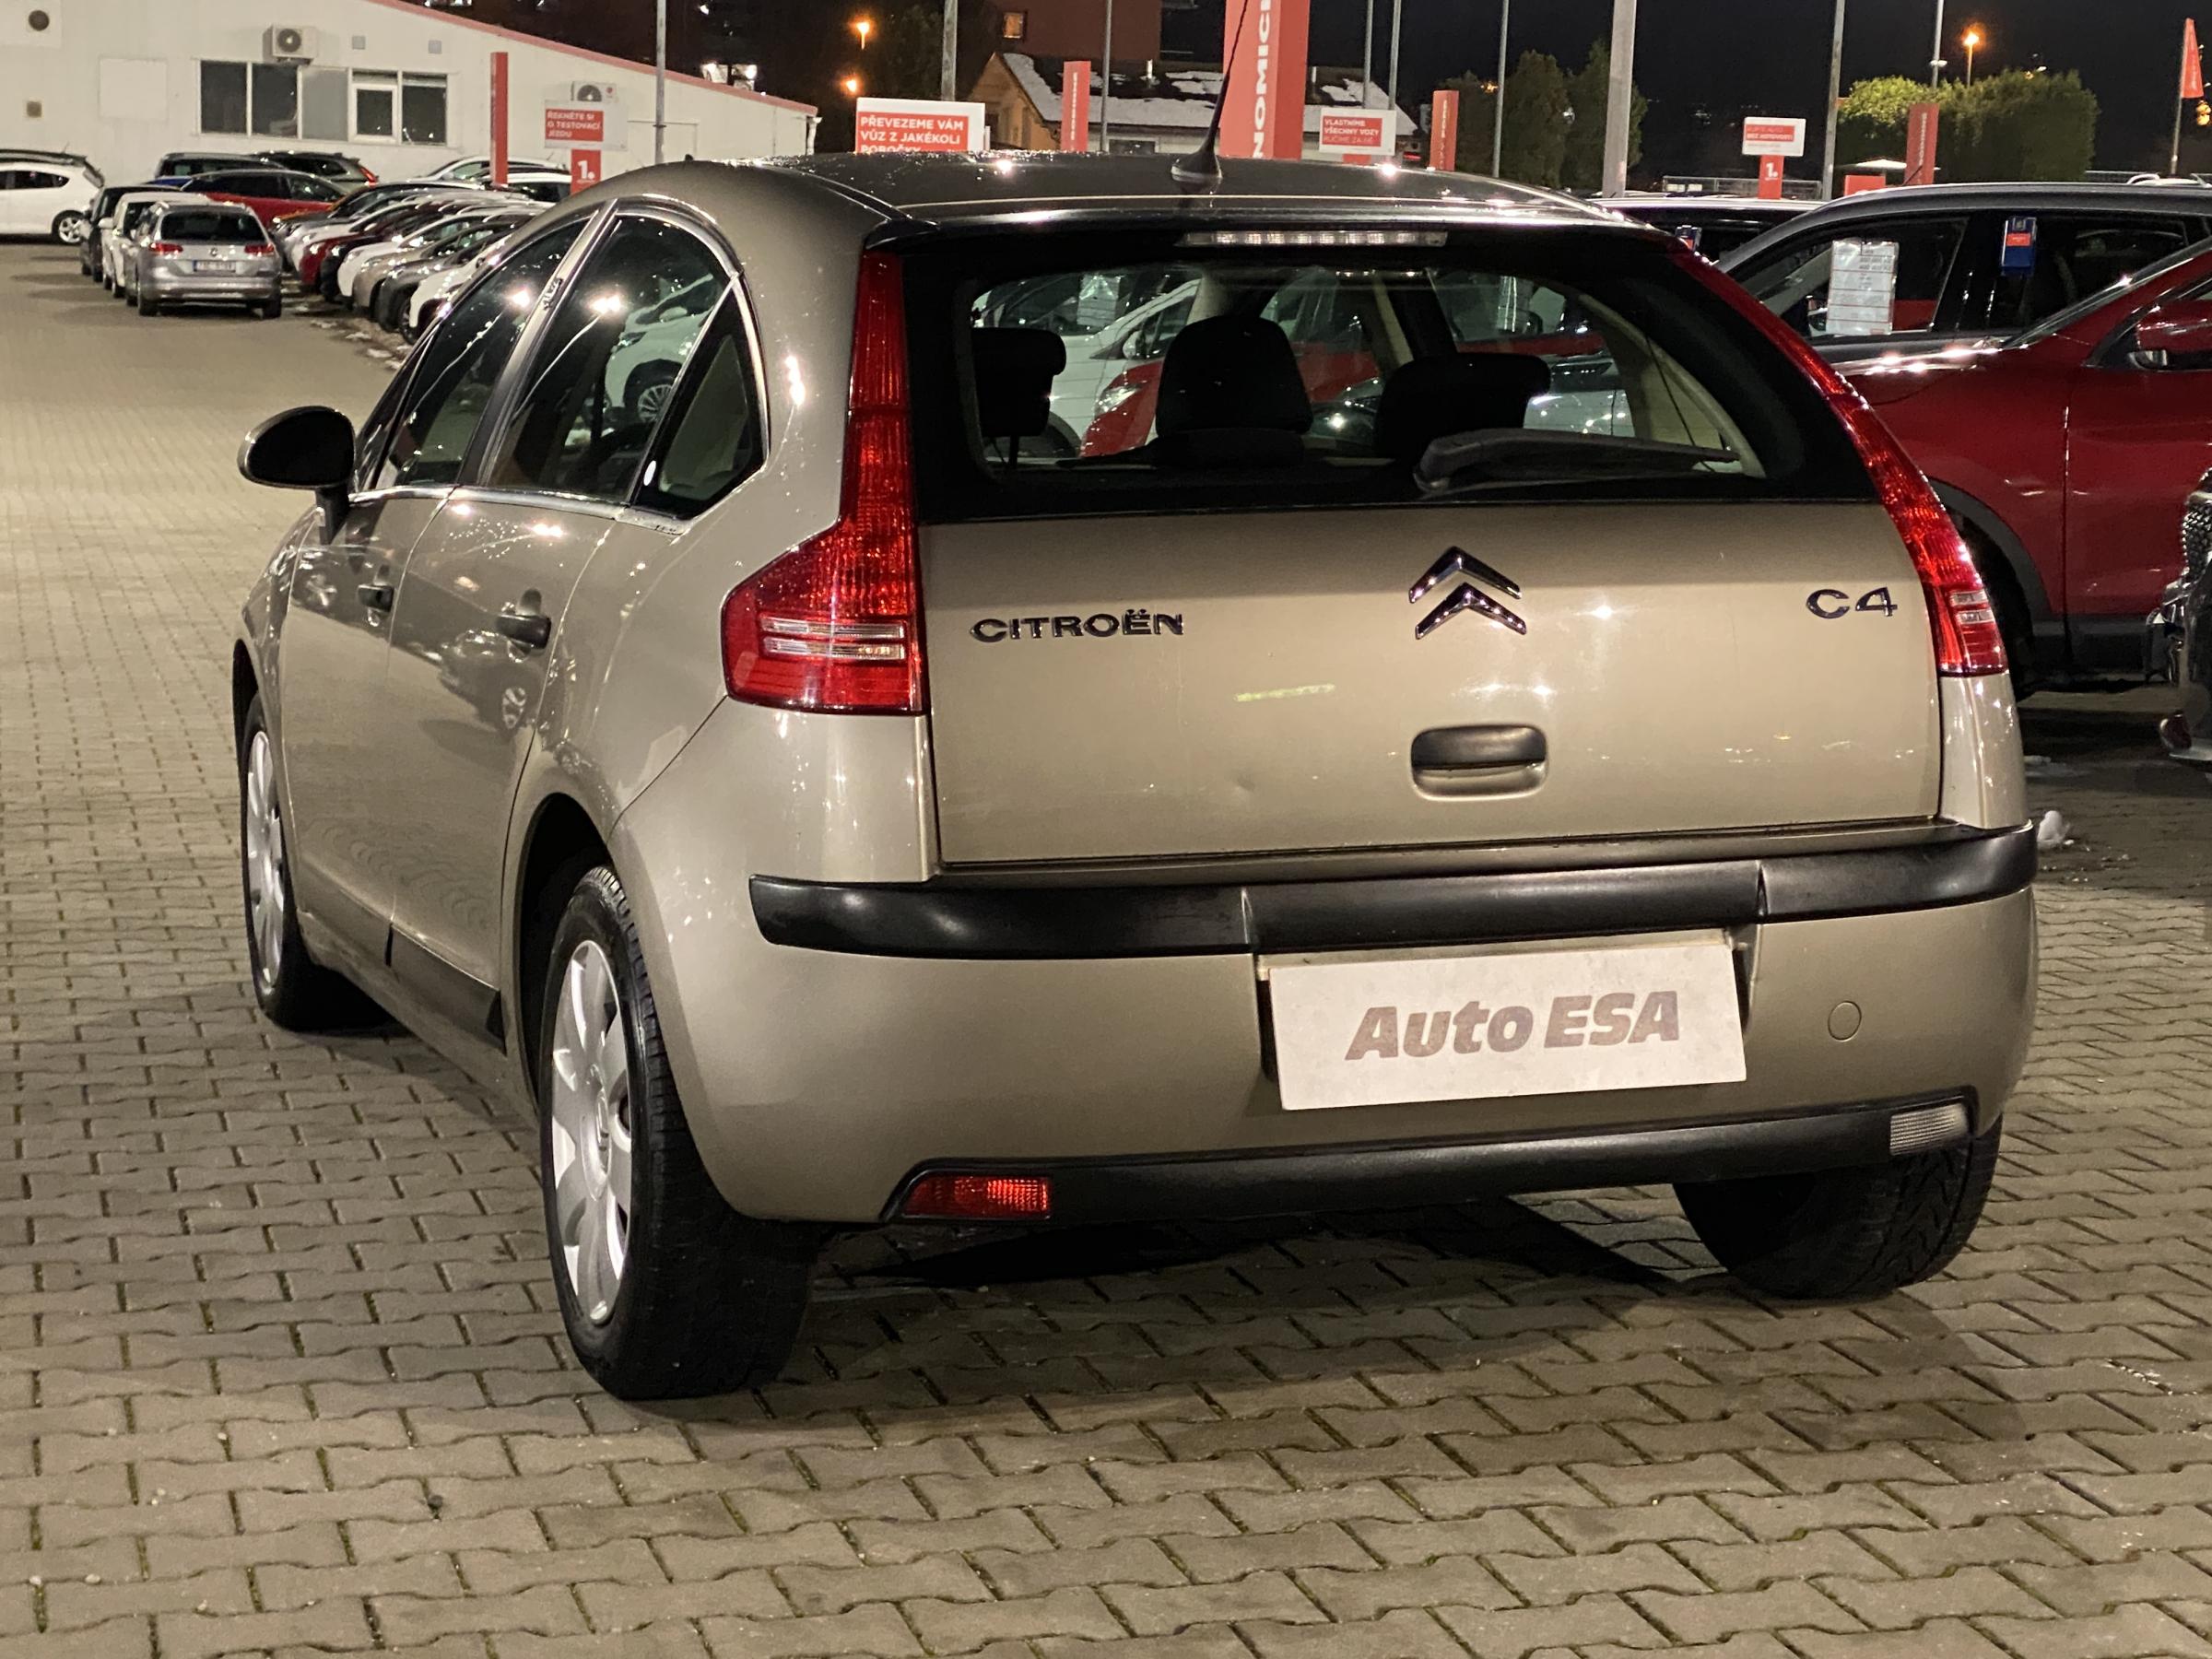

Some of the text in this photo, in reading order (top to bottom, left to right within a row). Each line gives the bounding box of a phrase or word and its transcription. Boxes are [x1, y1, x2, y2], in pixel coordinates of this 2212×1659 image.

[860, 115, 964, 131] PŘEVEZEME VÁM
[860, 129, 960, 145] VŮZ Z JAKÉKOLI
[577, 160, 595, 180] 1.
[1766, 162, 1779, 178] 1.
[970, 586, 1898, 642] CITROËN C4
[1344, 990, 1680, 1062] Auto ESA
